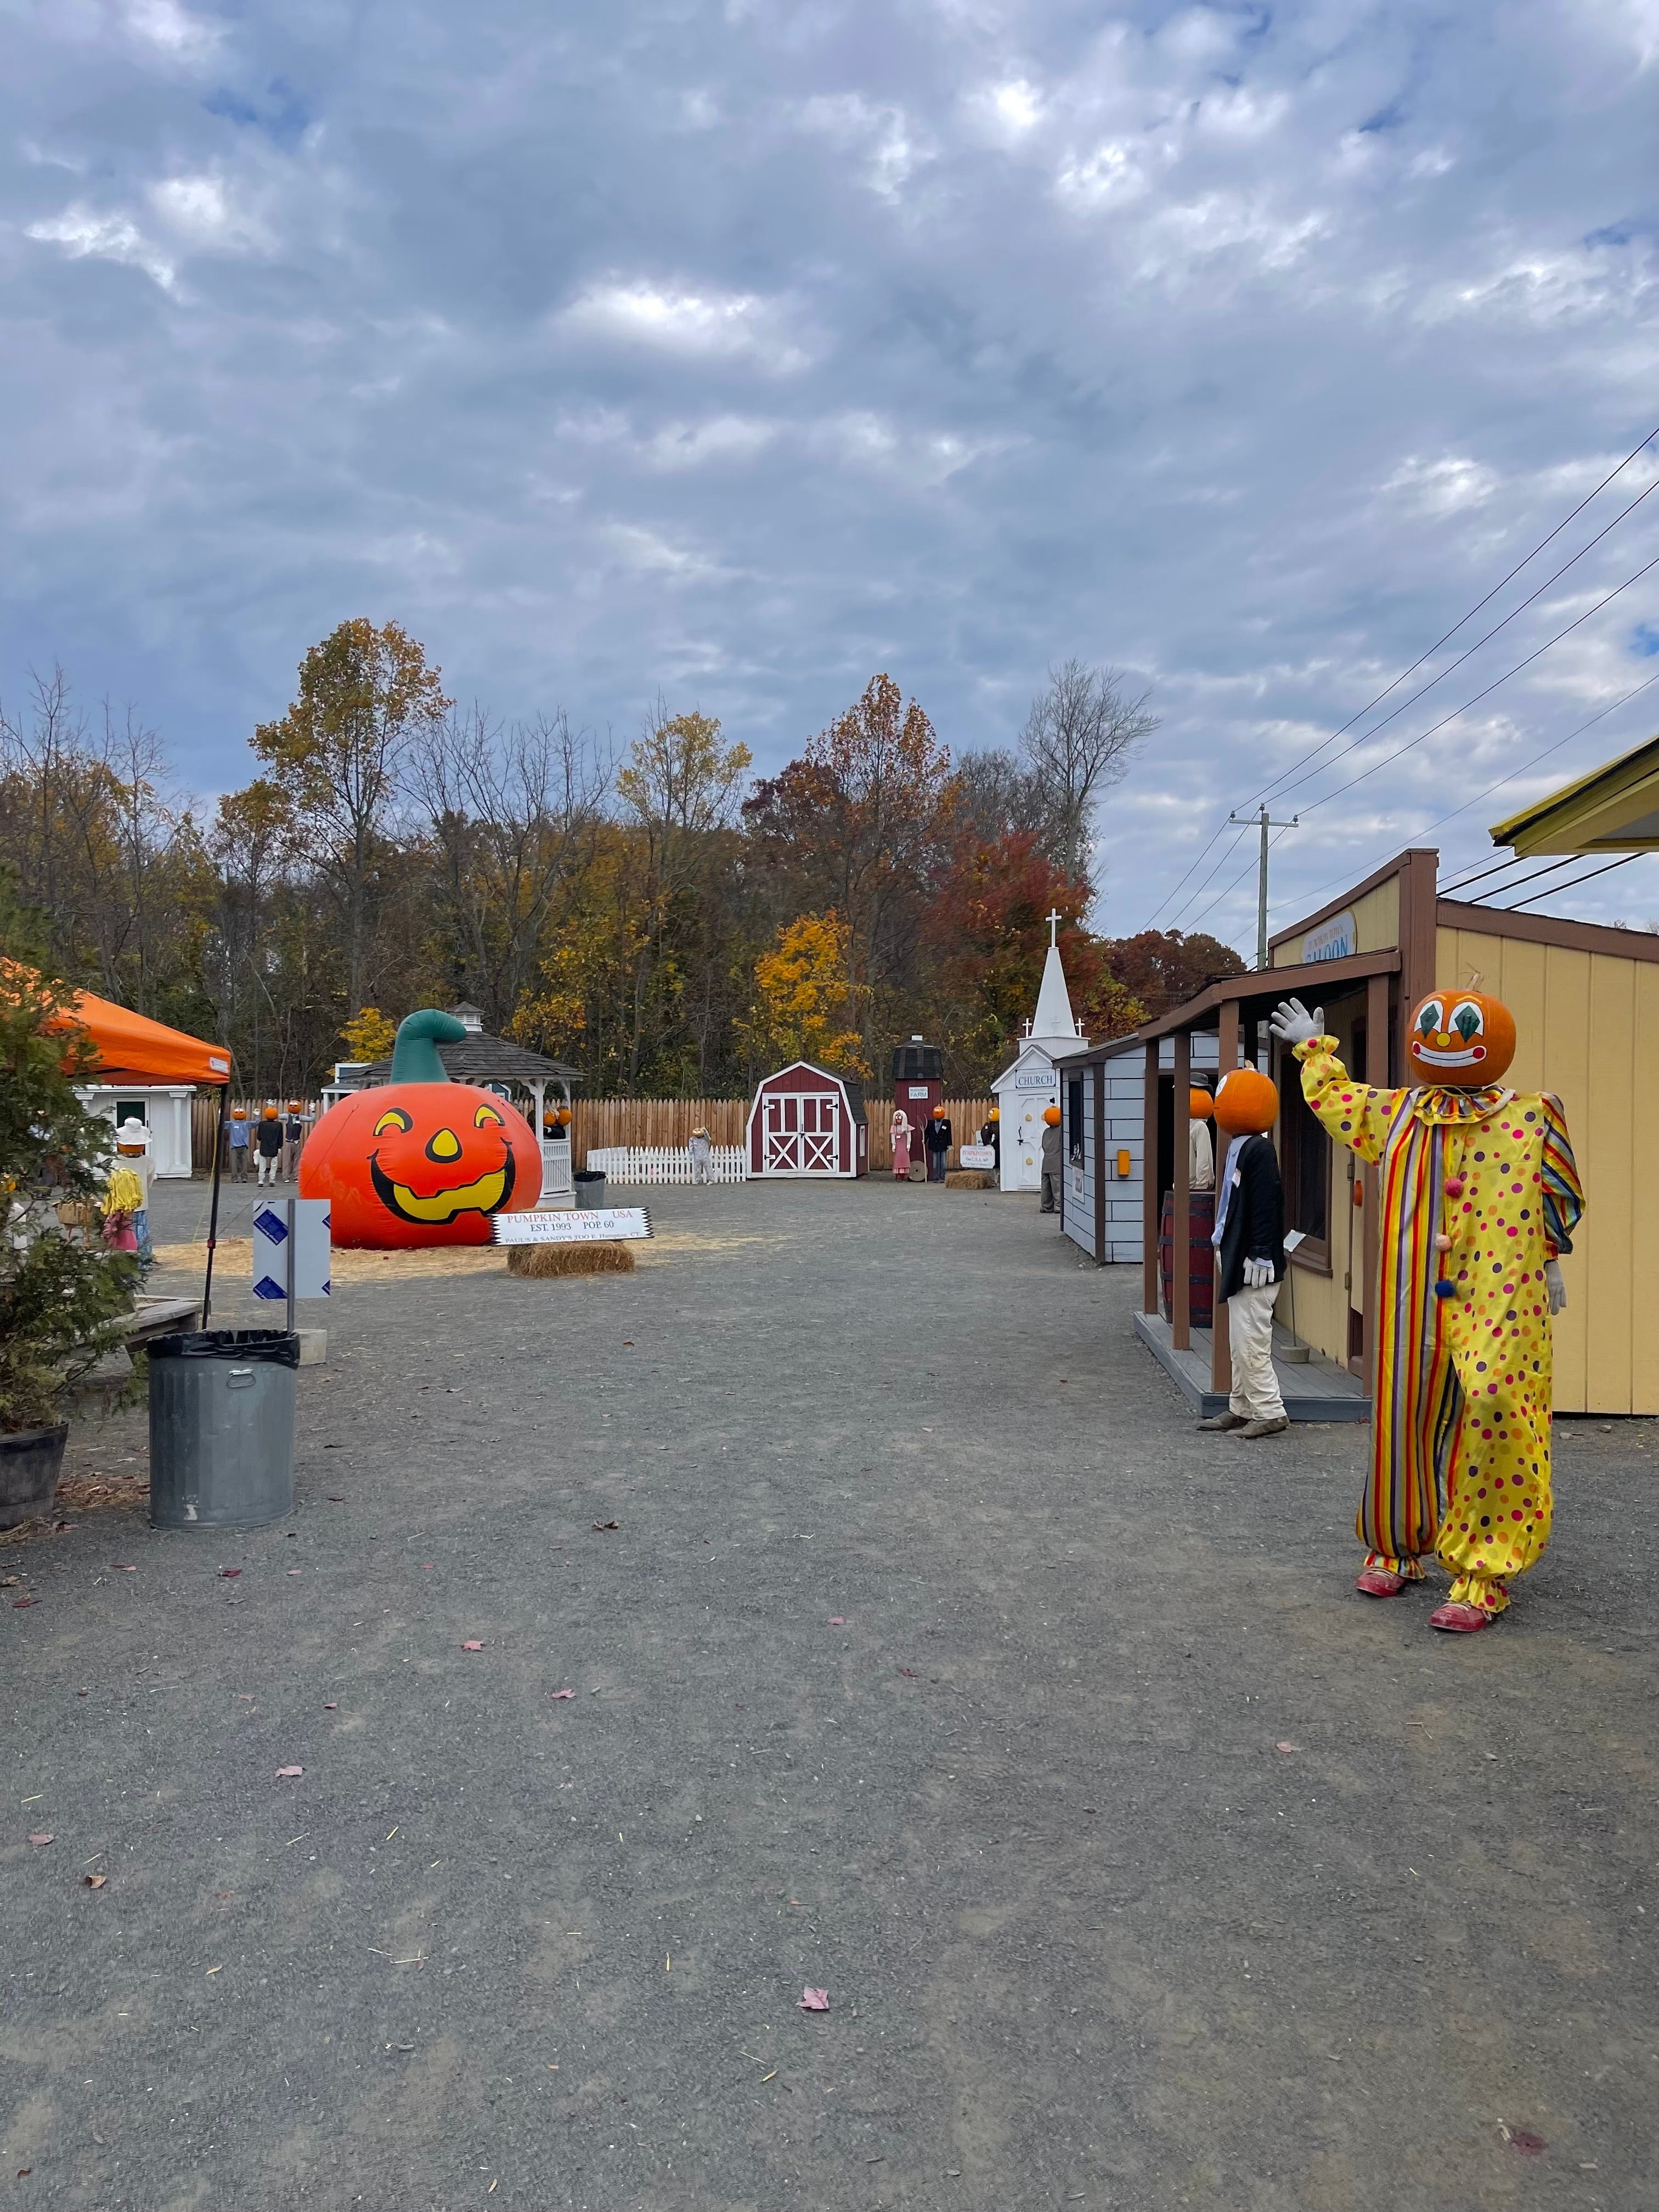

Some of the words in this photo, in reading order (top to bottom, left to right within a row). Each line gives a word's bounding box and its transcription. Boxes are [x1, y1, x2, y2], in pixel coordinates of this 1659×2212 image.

[1018, 1075, 1052, 1085] CHURCH
[507, 1213, 561, 1223] PUMPKIN
[563, 1211, 599, 1221] TOWN
[612, 1210, 633, 1218] USA
[530, 1224, 549, 1232] EST.
[583, 1221, 602, 1229] POP.
[604, 1220, 614, 1228] 60
